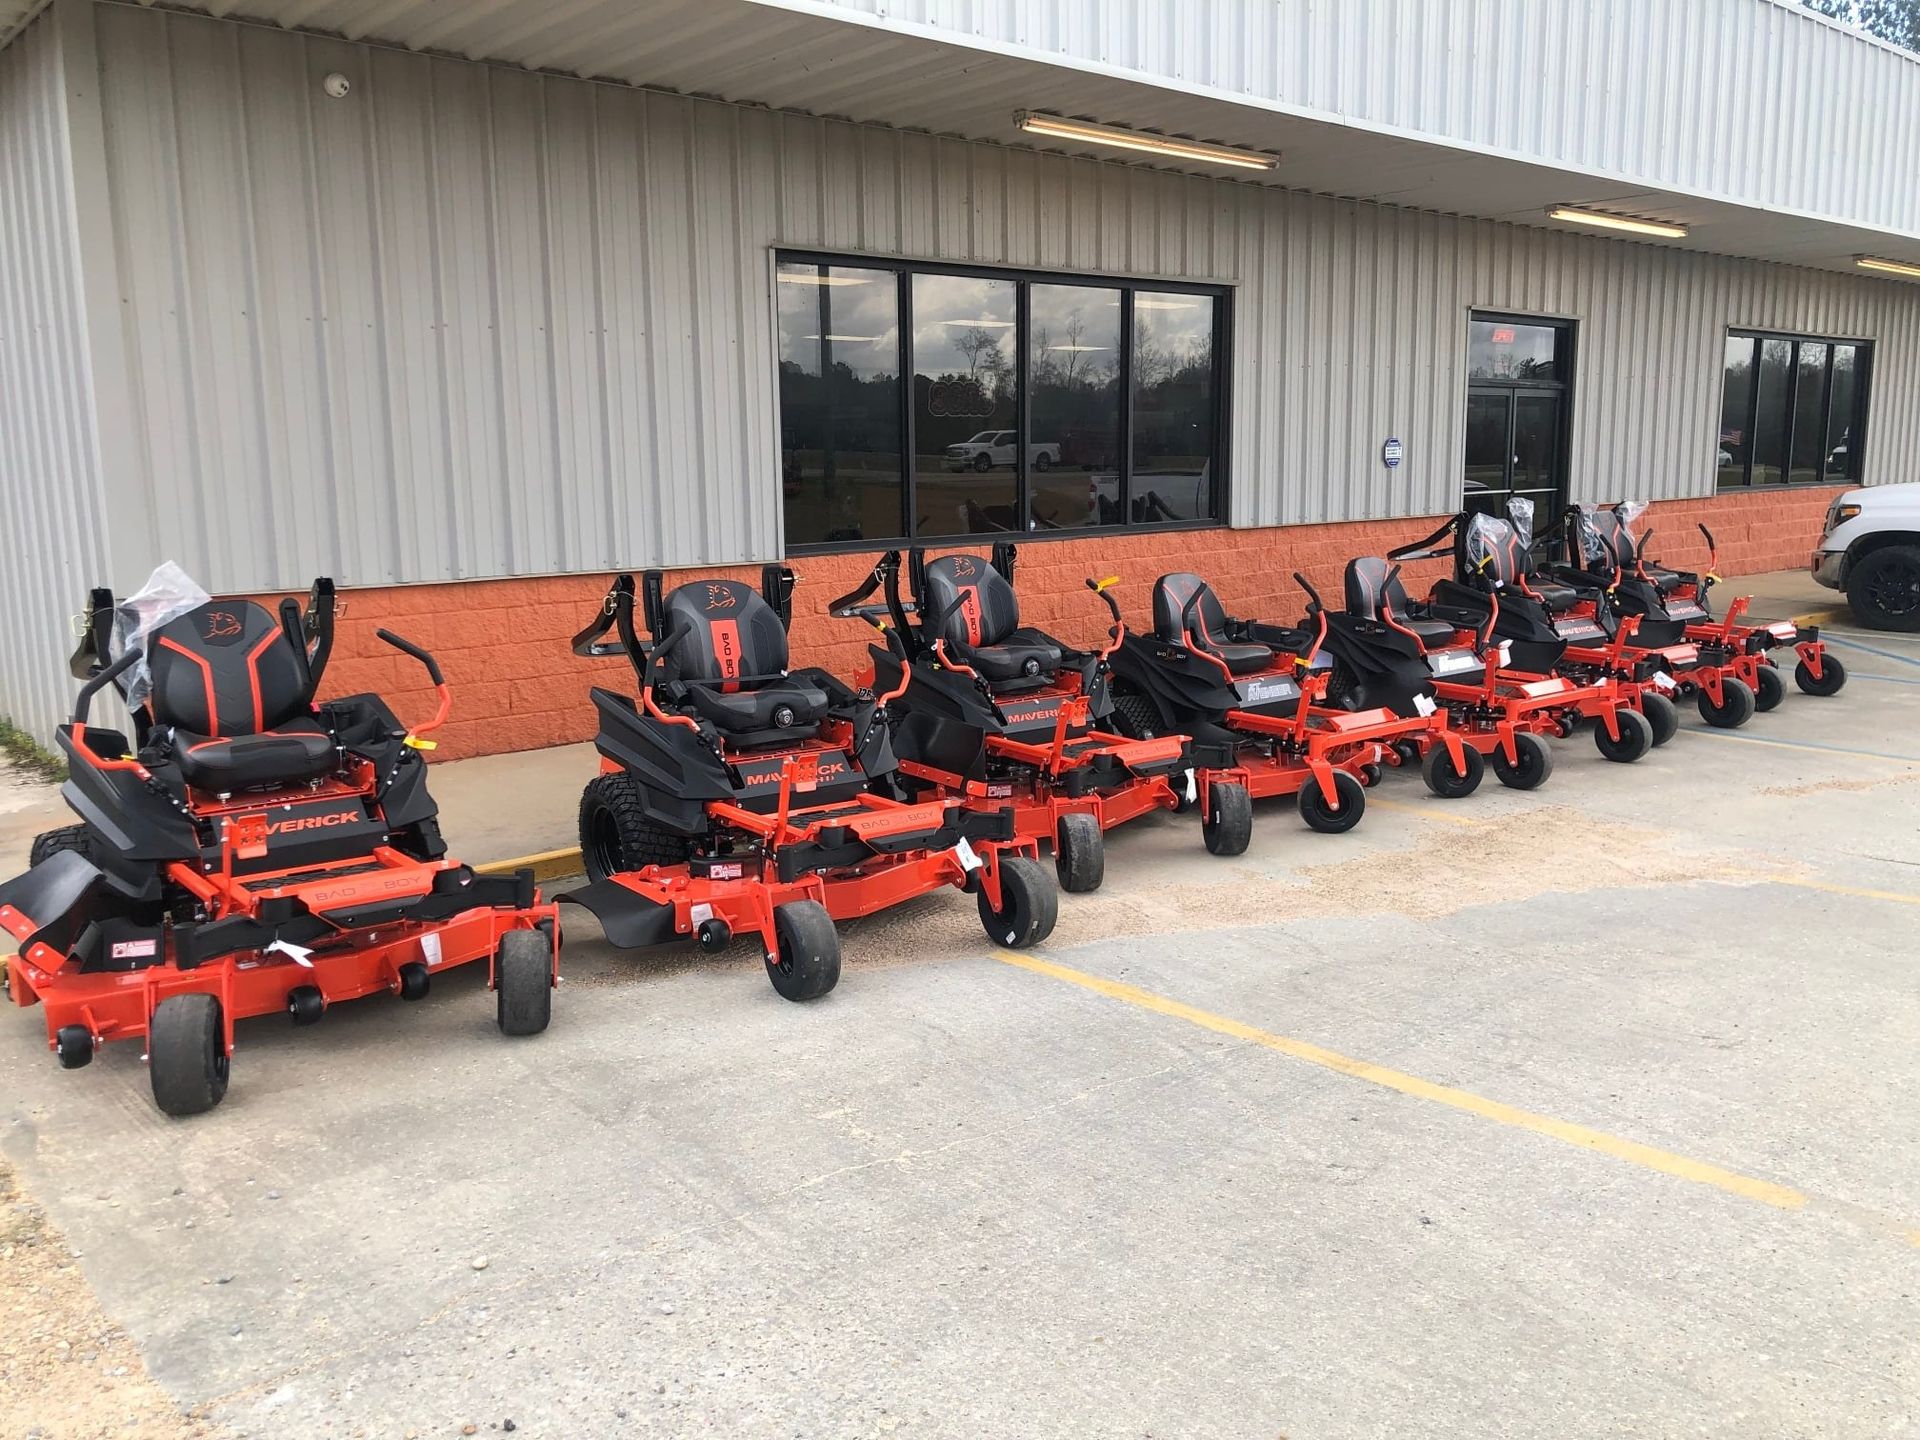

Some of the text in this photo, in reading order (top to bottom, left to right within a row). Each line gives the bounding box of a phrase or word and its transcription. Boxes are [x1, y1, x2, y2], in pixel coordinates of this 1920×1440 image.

[721, 632, 732, 656] BAD
[1007, 708, 1060, 724] MAVERI
[264, 810, 360, 835] VERICK
[315, 877, 421, 901] BAD BOY
